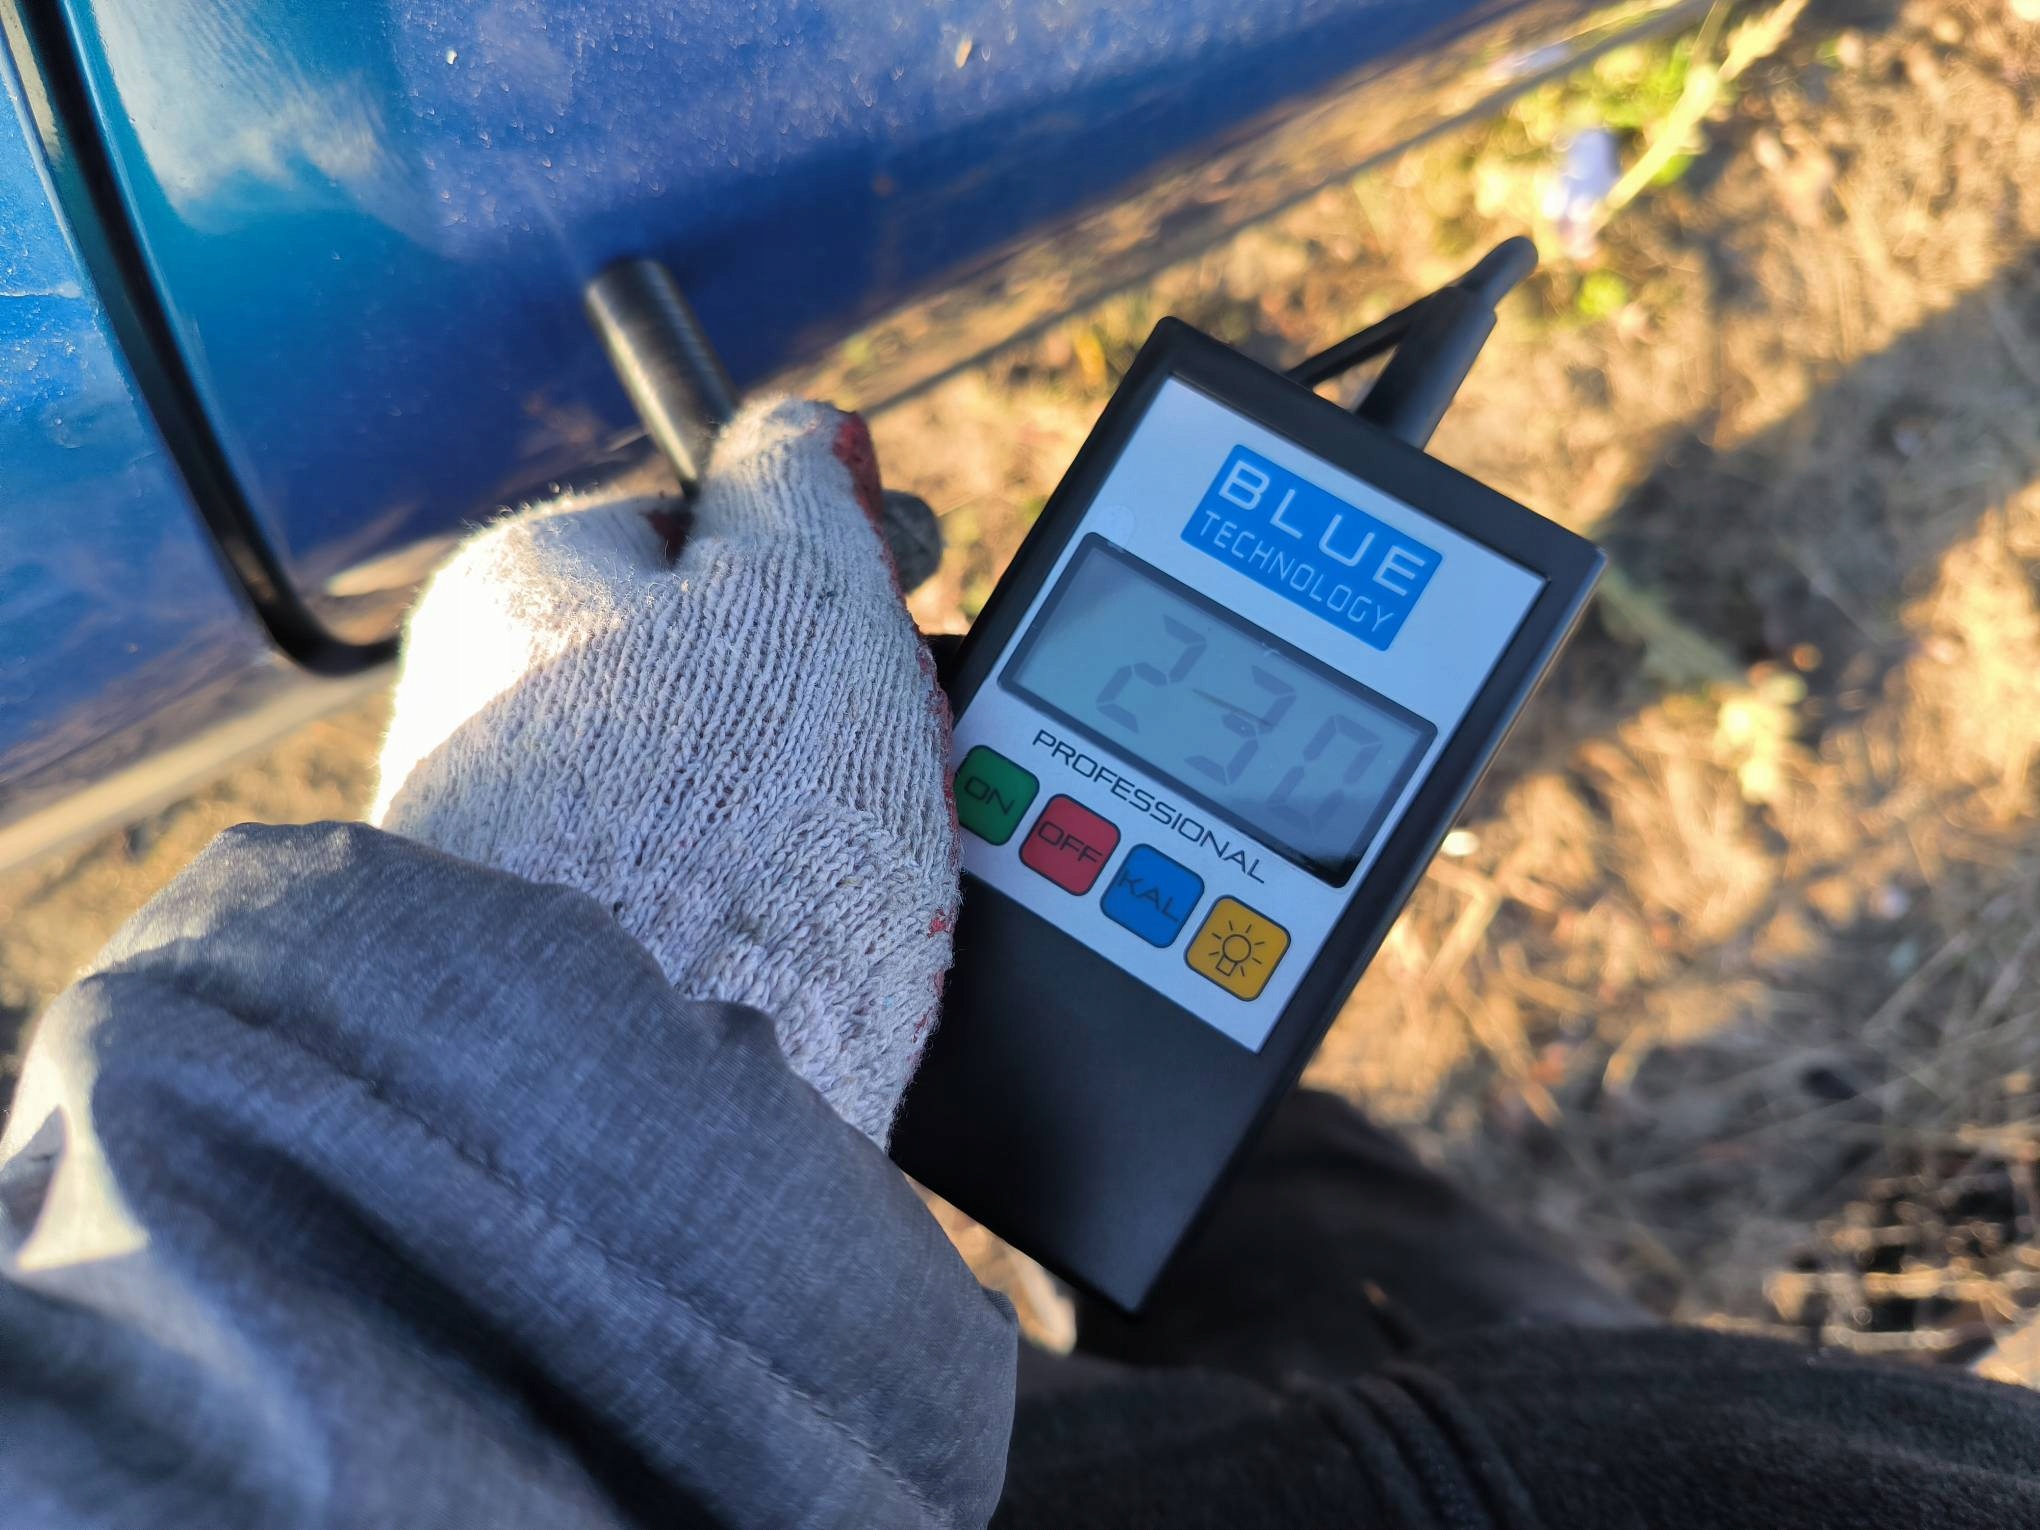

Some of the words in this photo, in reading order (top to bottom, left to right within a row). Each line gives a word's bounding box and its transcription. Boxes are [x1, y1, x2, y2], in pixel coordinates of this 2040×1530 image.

[1200, 510, 1394, 632] TECHNOLOGY
[1218, 460, 1426, 597] BLUE
[1096, 614, 1383, 833] 230
[964, 776, 1014, 816] ON
[1032, 729, 1265, 884] PROFESSIONAL
[1038, 821, 1102, 864] OFF
[1117, 868, 1179, 923] KAL
